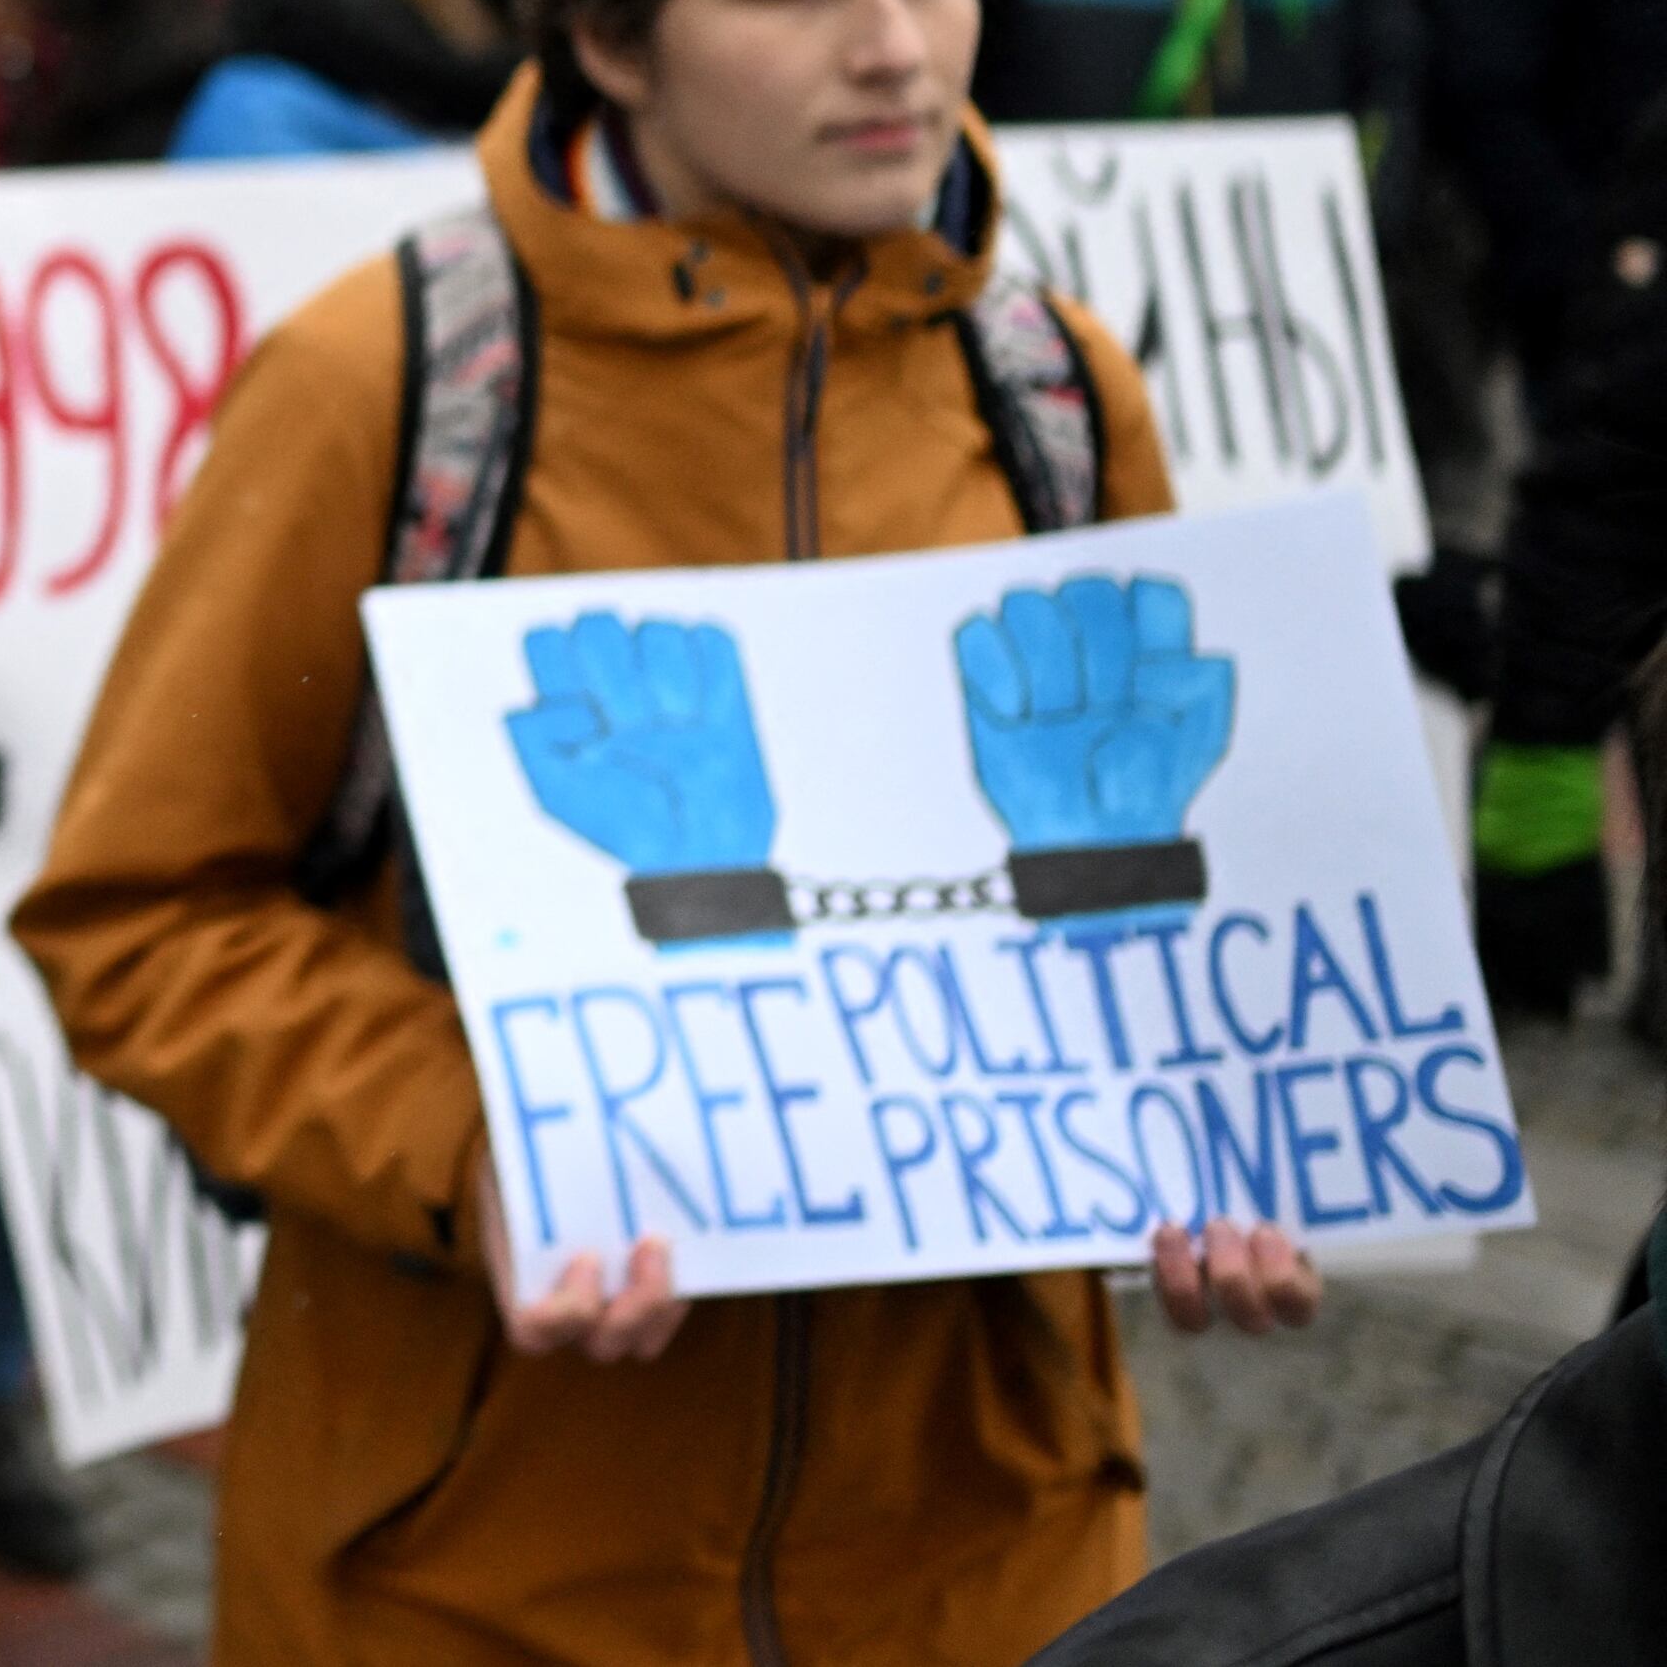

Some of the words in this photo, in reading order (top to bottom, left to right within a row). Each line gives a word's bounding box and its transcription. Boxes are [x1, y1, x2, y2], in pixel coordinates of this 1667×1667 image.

[820, 893, 1465, 1085] POLITICAL
[489, 975, 865, 1245] FREE
[867, 1043, 1525, 1251] PRISONERS
